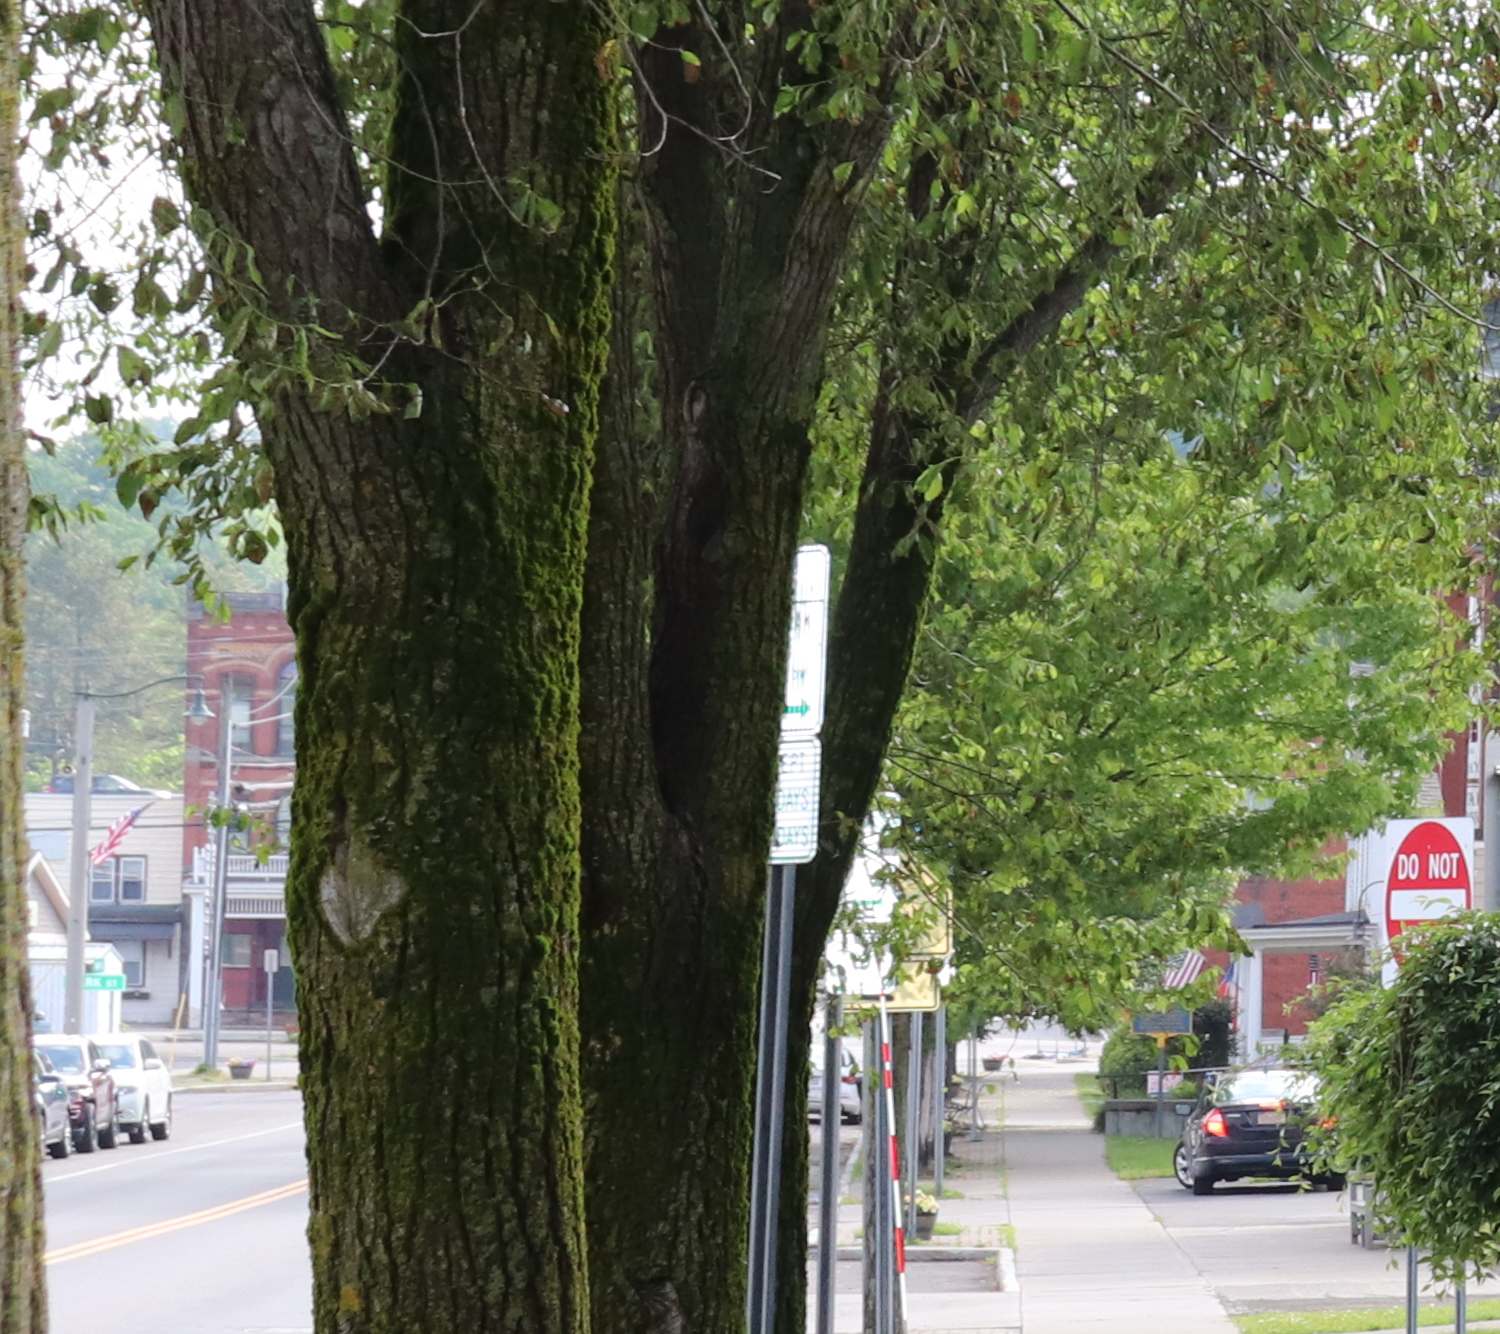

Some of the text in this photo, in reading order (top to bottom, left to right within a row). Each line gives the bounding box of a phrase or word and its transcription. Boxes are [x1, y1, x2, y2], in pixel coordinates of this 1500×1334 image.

[1397, 852, 1460, 880] DO NOT
[105, 979, 118, 988] ST
